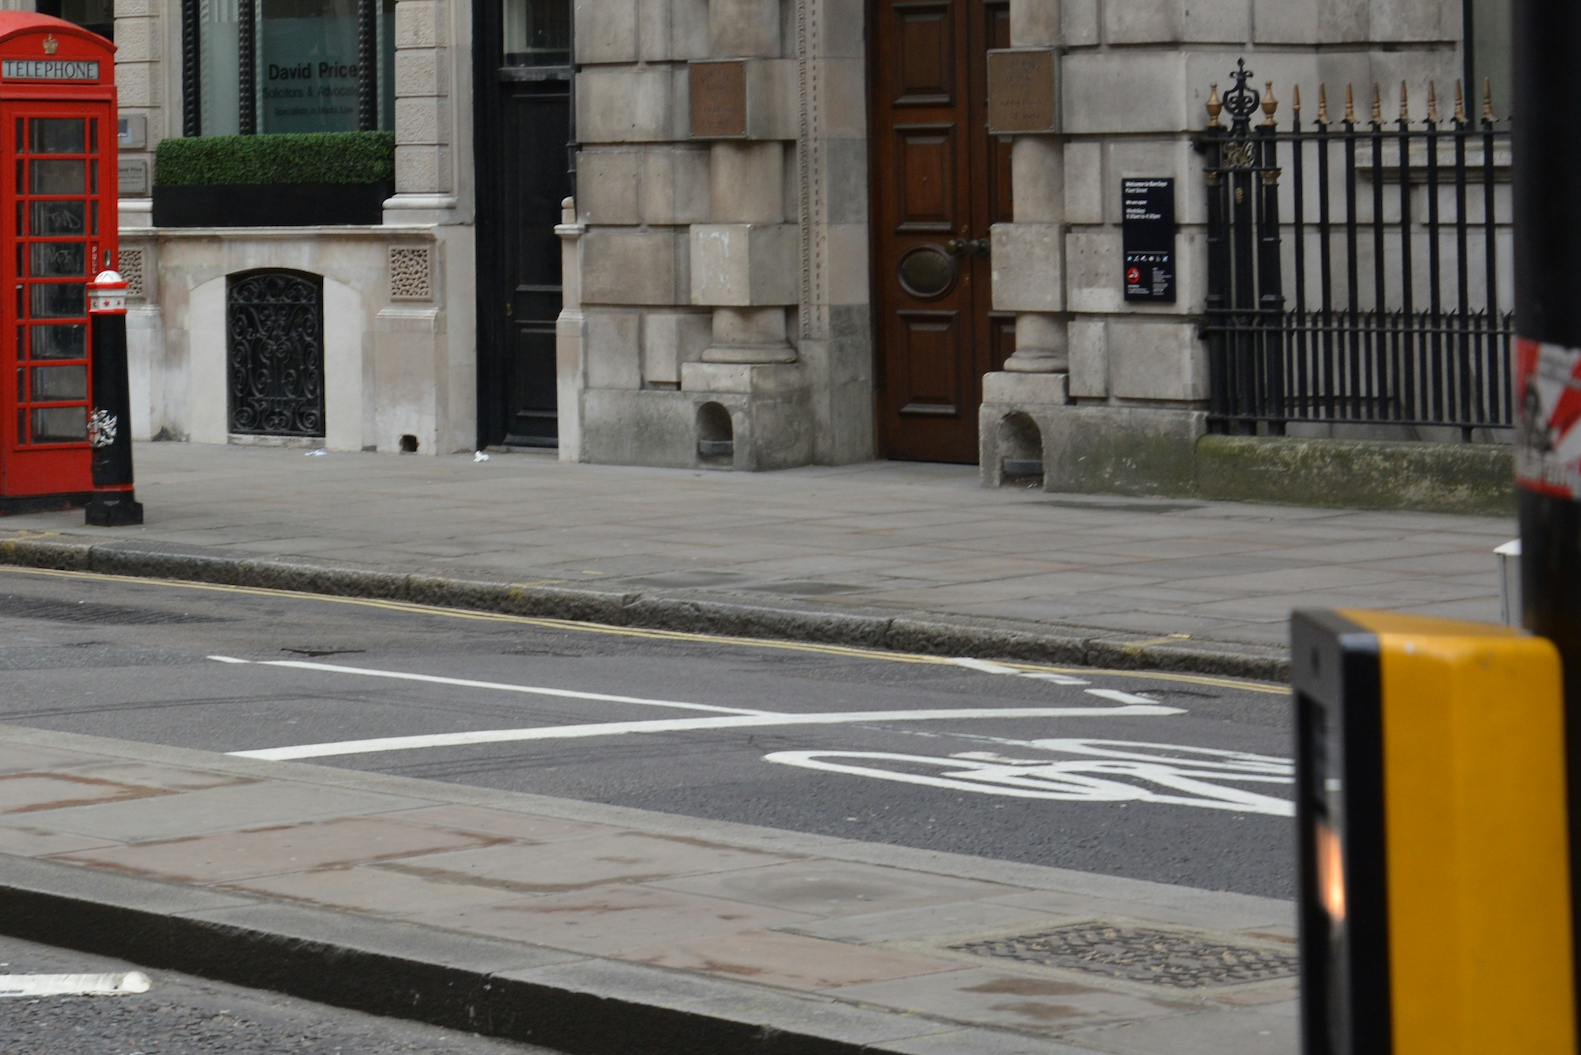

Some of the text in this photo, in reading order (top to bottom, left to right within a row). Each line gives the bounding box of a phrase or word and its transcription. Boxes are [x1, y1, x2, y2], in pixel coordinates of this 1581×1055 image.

[4, 60, 96, 79] TELEPHONE
[269, 61, 358, 80] David Price
[263, 87, 303, 99] Solicitors
[317, 85, 359, 97] Advocate
